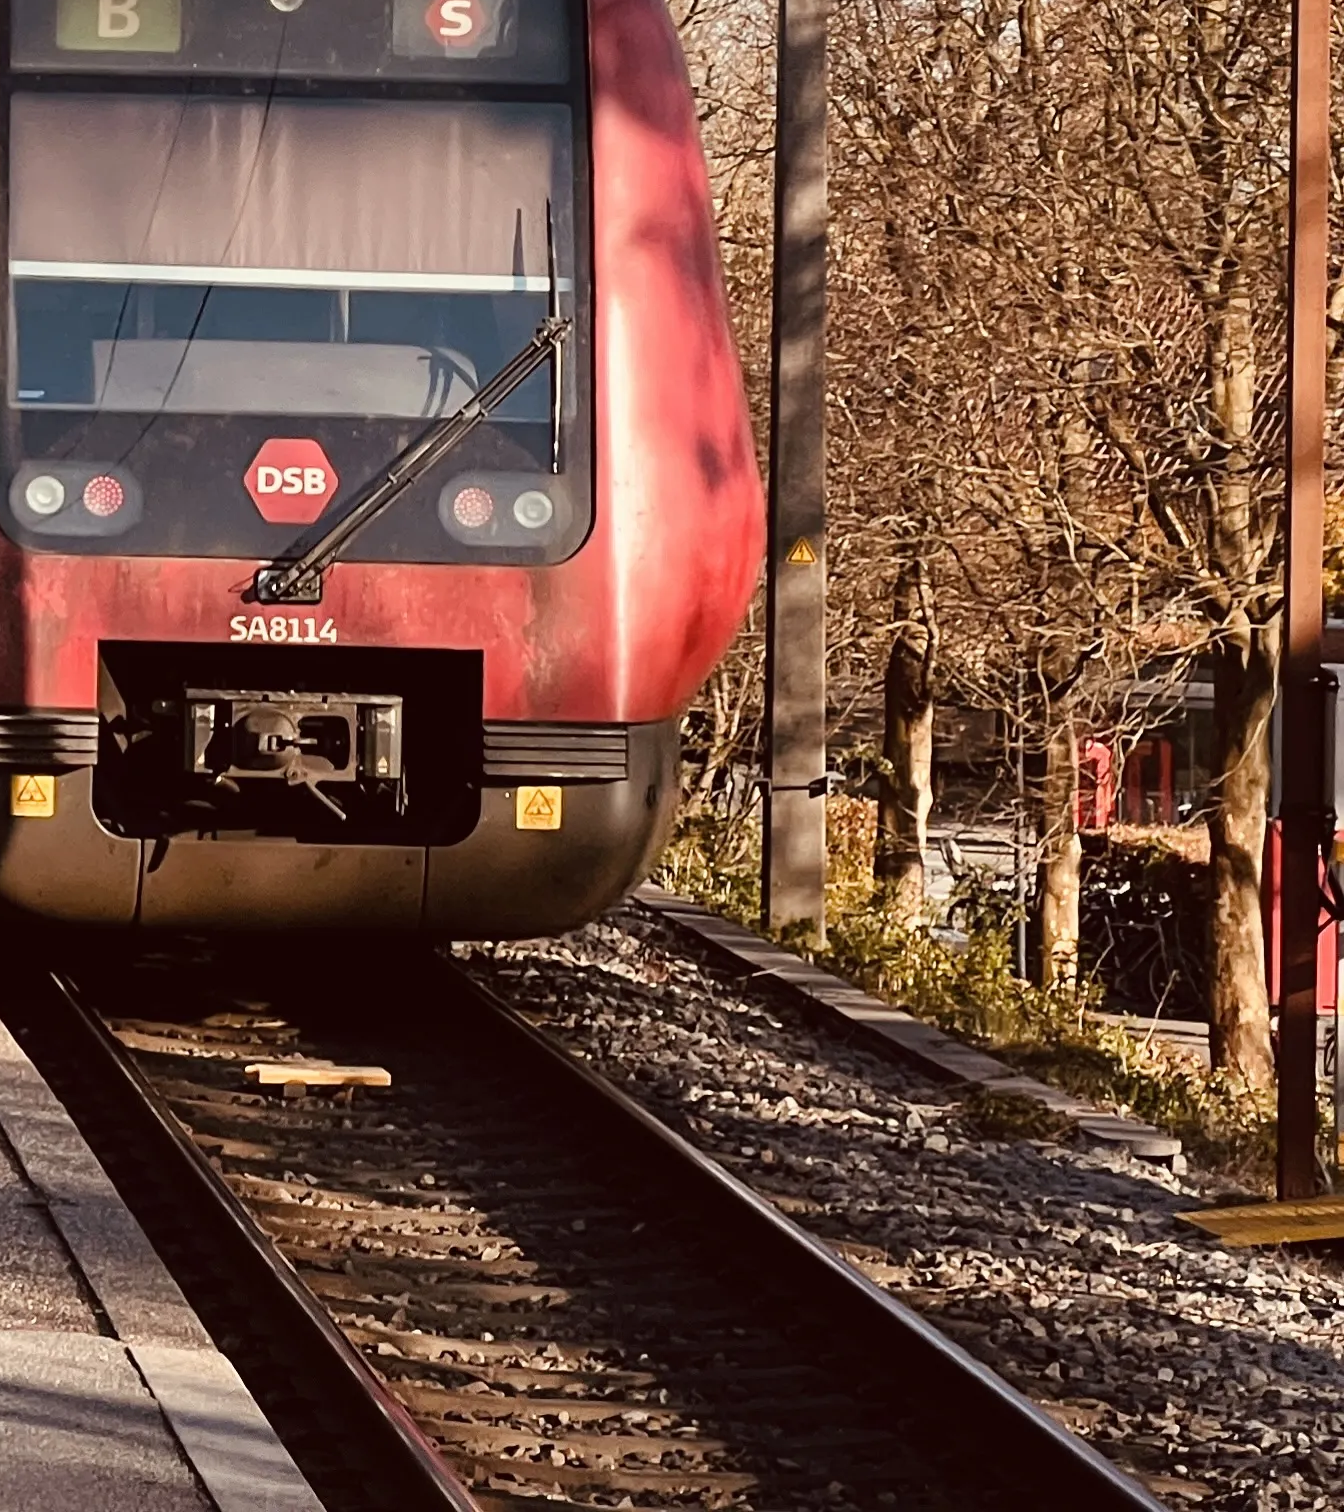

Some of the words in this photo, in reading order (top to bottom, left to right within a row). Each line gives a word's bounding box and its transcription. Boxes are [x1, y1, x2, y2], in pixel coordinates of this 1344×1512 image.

[439, 0, 473, 36] S
[257, 466, 327, 495] DSB
[230, 615, 337, 643] SA8114
